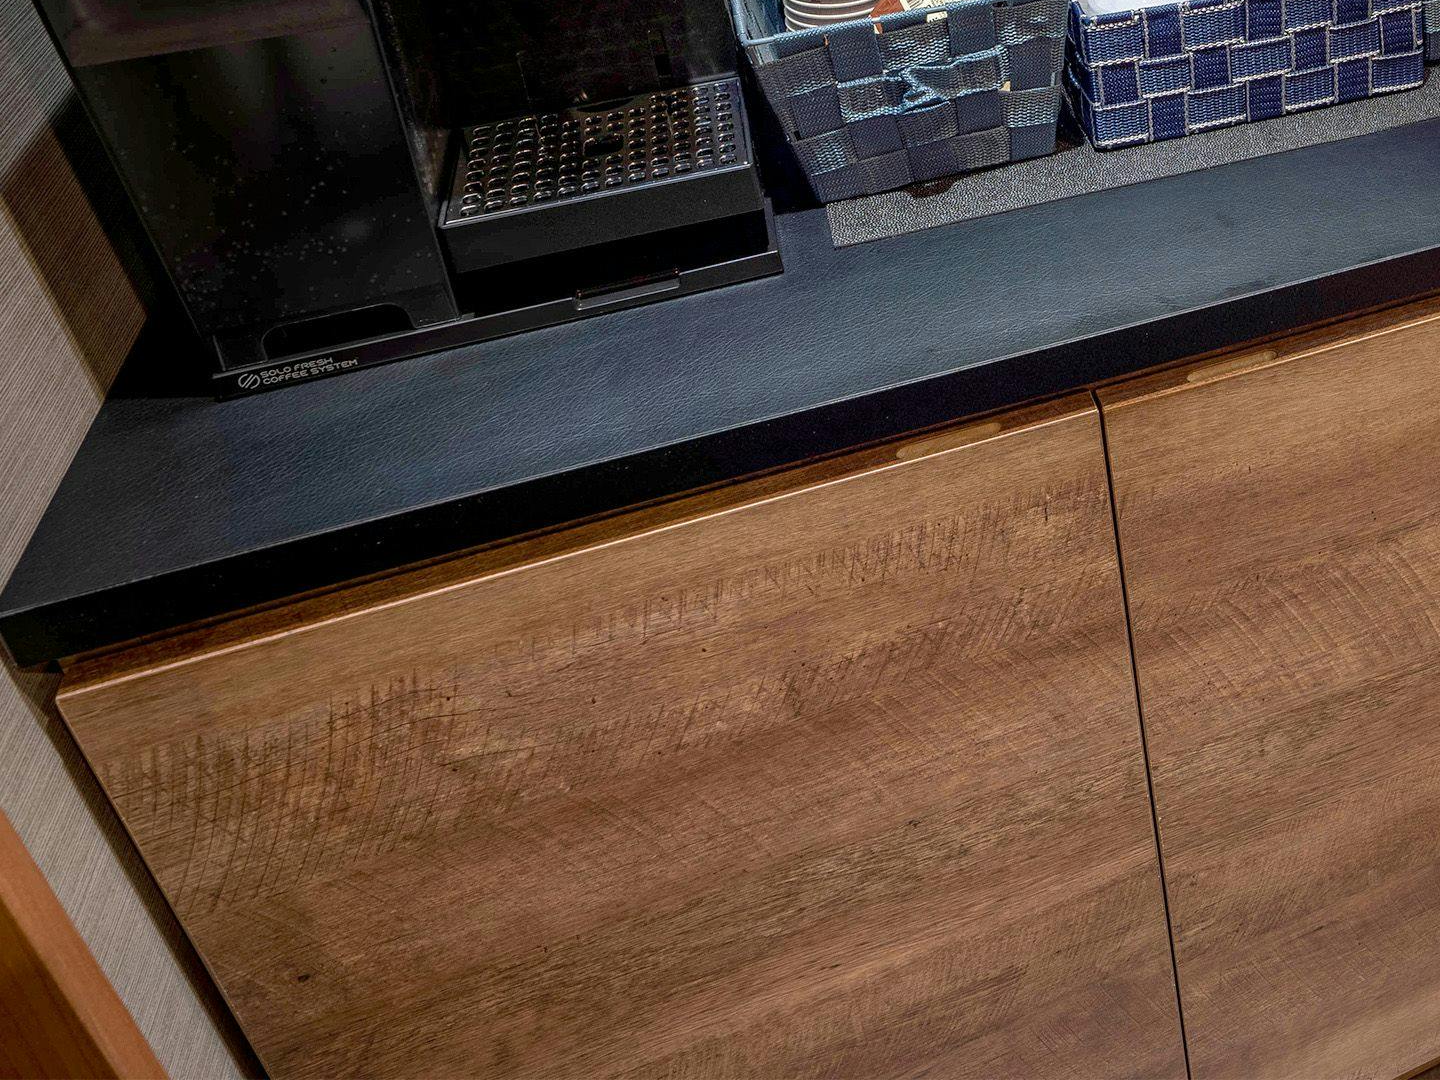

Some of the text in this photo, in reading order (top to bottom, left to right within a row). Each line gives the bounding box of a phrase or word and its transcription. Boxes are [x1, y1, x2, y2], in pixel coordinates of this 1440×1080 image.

[260, 357, 333, 378] SOLO FRESH
[263, 359, 358, 385] COFFEE SYSTEM
